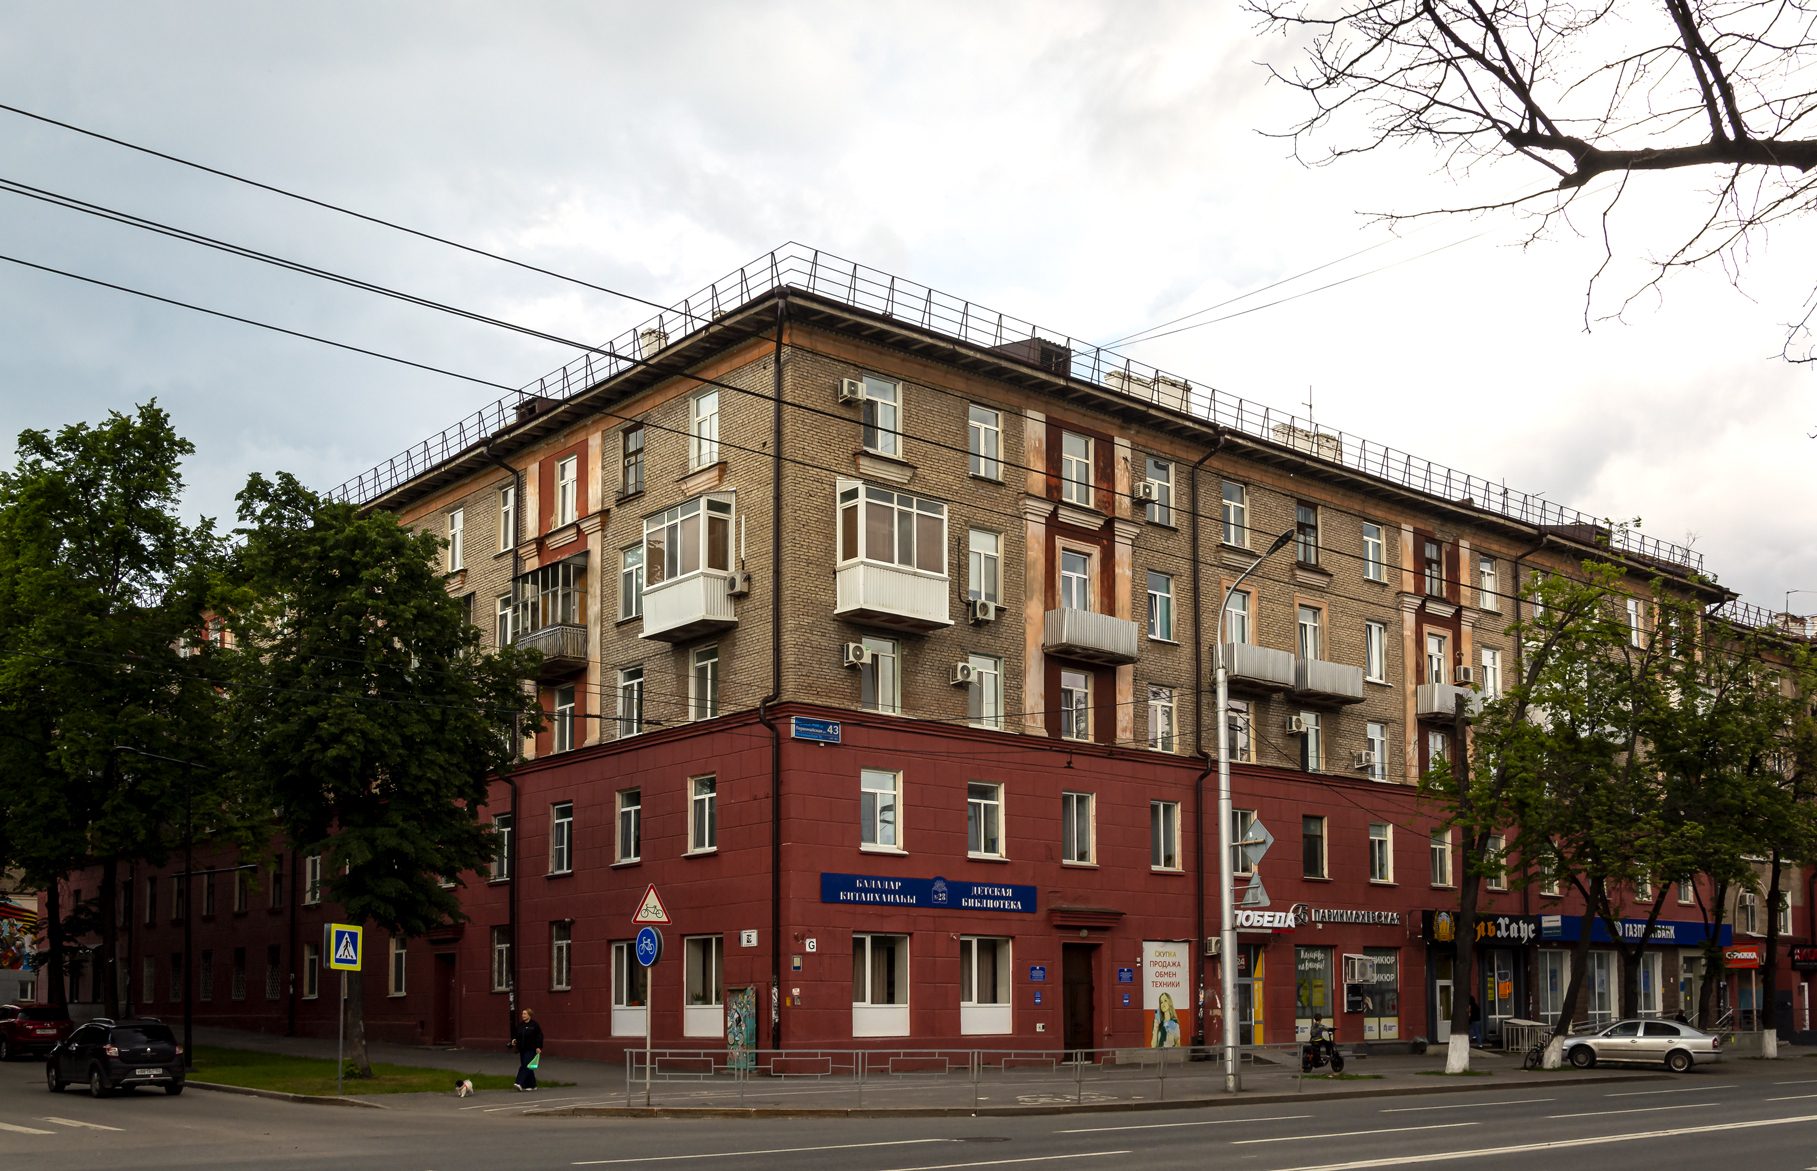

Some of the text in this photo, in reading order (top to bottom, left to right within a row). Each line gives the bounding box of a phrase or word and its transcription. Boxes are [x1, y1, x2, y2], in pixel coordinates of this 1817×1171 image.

[826, 725, 839, 735] 43
[856, 879, 902, 890] БАЛАЛАР
[971, 886, 1013, 897] ДЕТСКАЯ
[961, 898, 1022, 910] БИБЛИОТЕКА
[1311, 909, 1400, 925] ПАРИКМАХЕРСКАЯ
[808, 940, 815, 950] G
[1154, 950, 1177, 958] СКУПКА
[1149, 960, 1181, 969] ПРОДАЖА
[1151, 980, 1181, 988] ТЕХНИКИ
